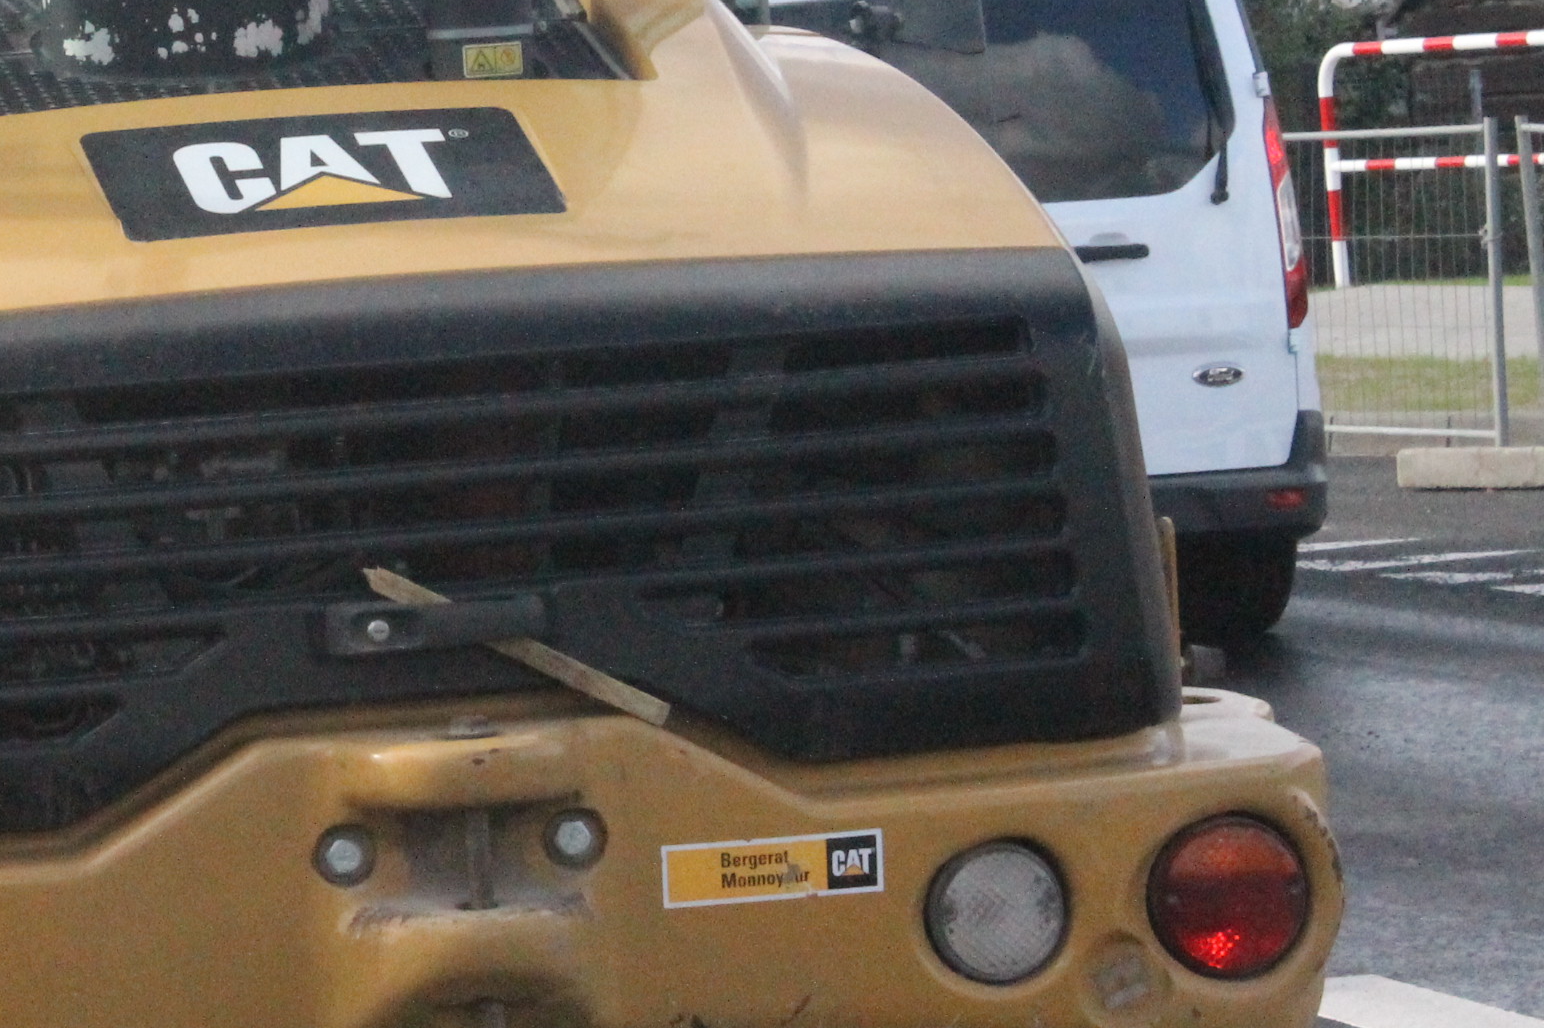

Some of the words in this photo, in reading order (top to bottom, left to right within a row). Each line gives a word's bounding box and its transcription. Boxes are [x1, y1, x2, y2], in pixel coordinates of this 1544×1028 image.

[173, 128, 453, 215] CAT
[720, 850, 789, 869] Bergerat
[831, 848, 873, 877] CAT
[721, 870, 810, 889] Monnoyur
